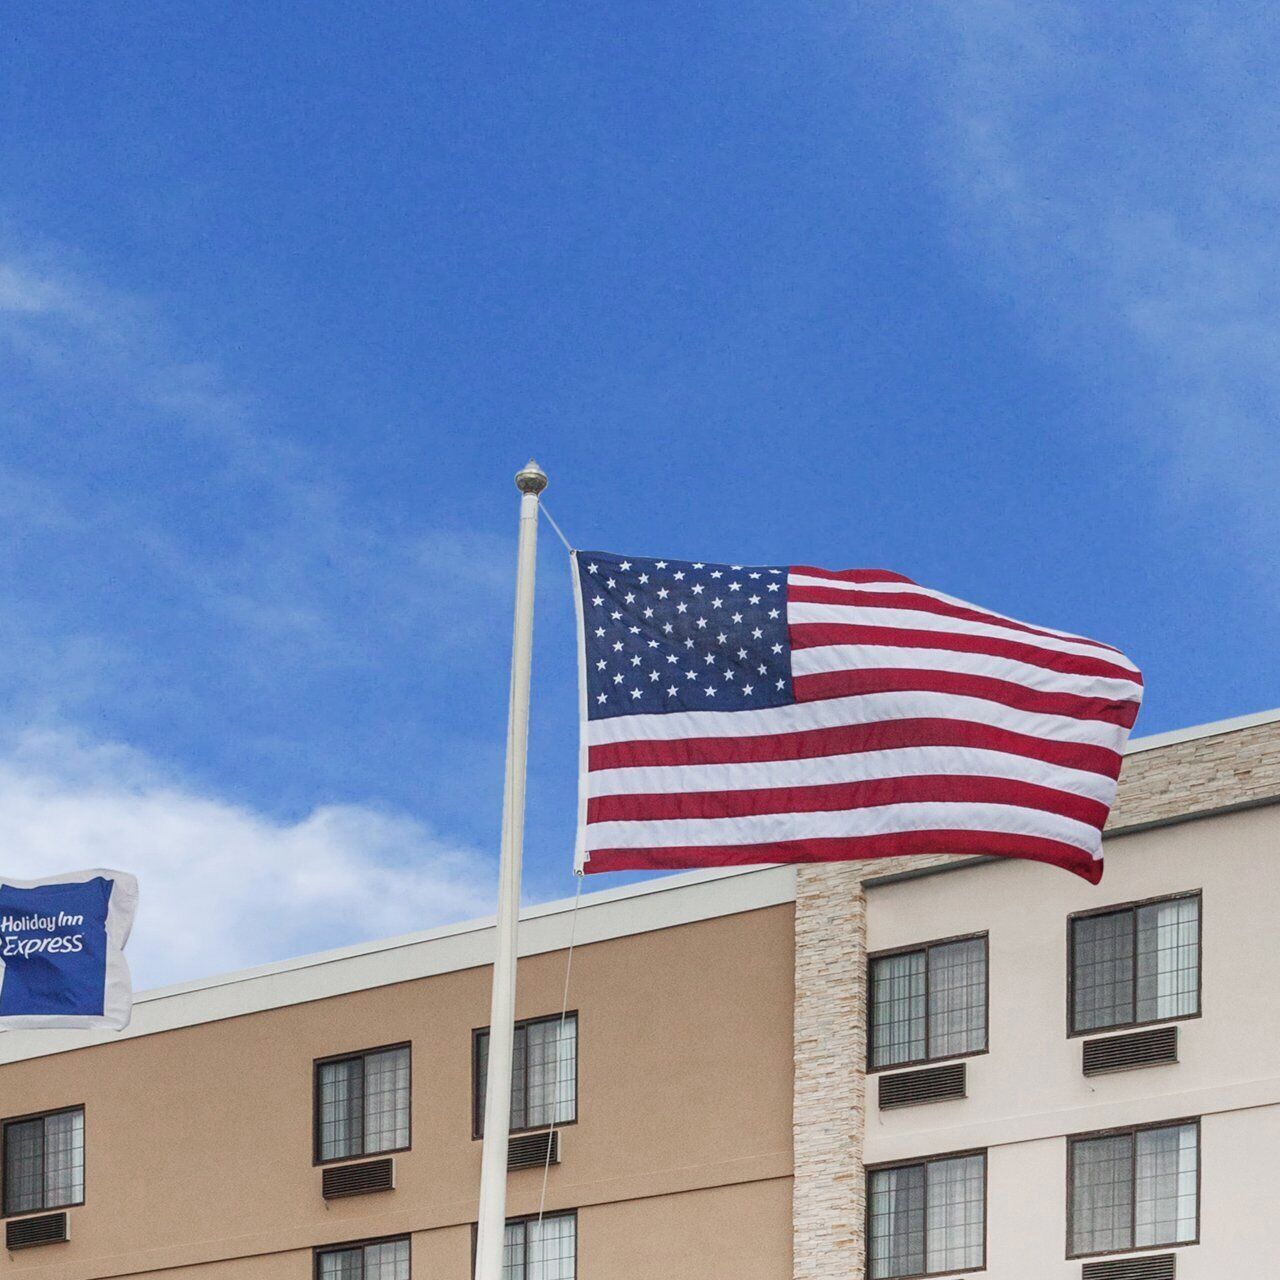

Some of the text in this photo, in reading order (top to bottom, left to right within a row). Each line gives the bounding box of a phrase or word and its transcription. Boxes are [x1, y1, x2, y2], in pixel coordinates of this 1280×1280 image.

[1, 911, 84, 932] Holiday Inn
[3, 934, 84, 959] Express
